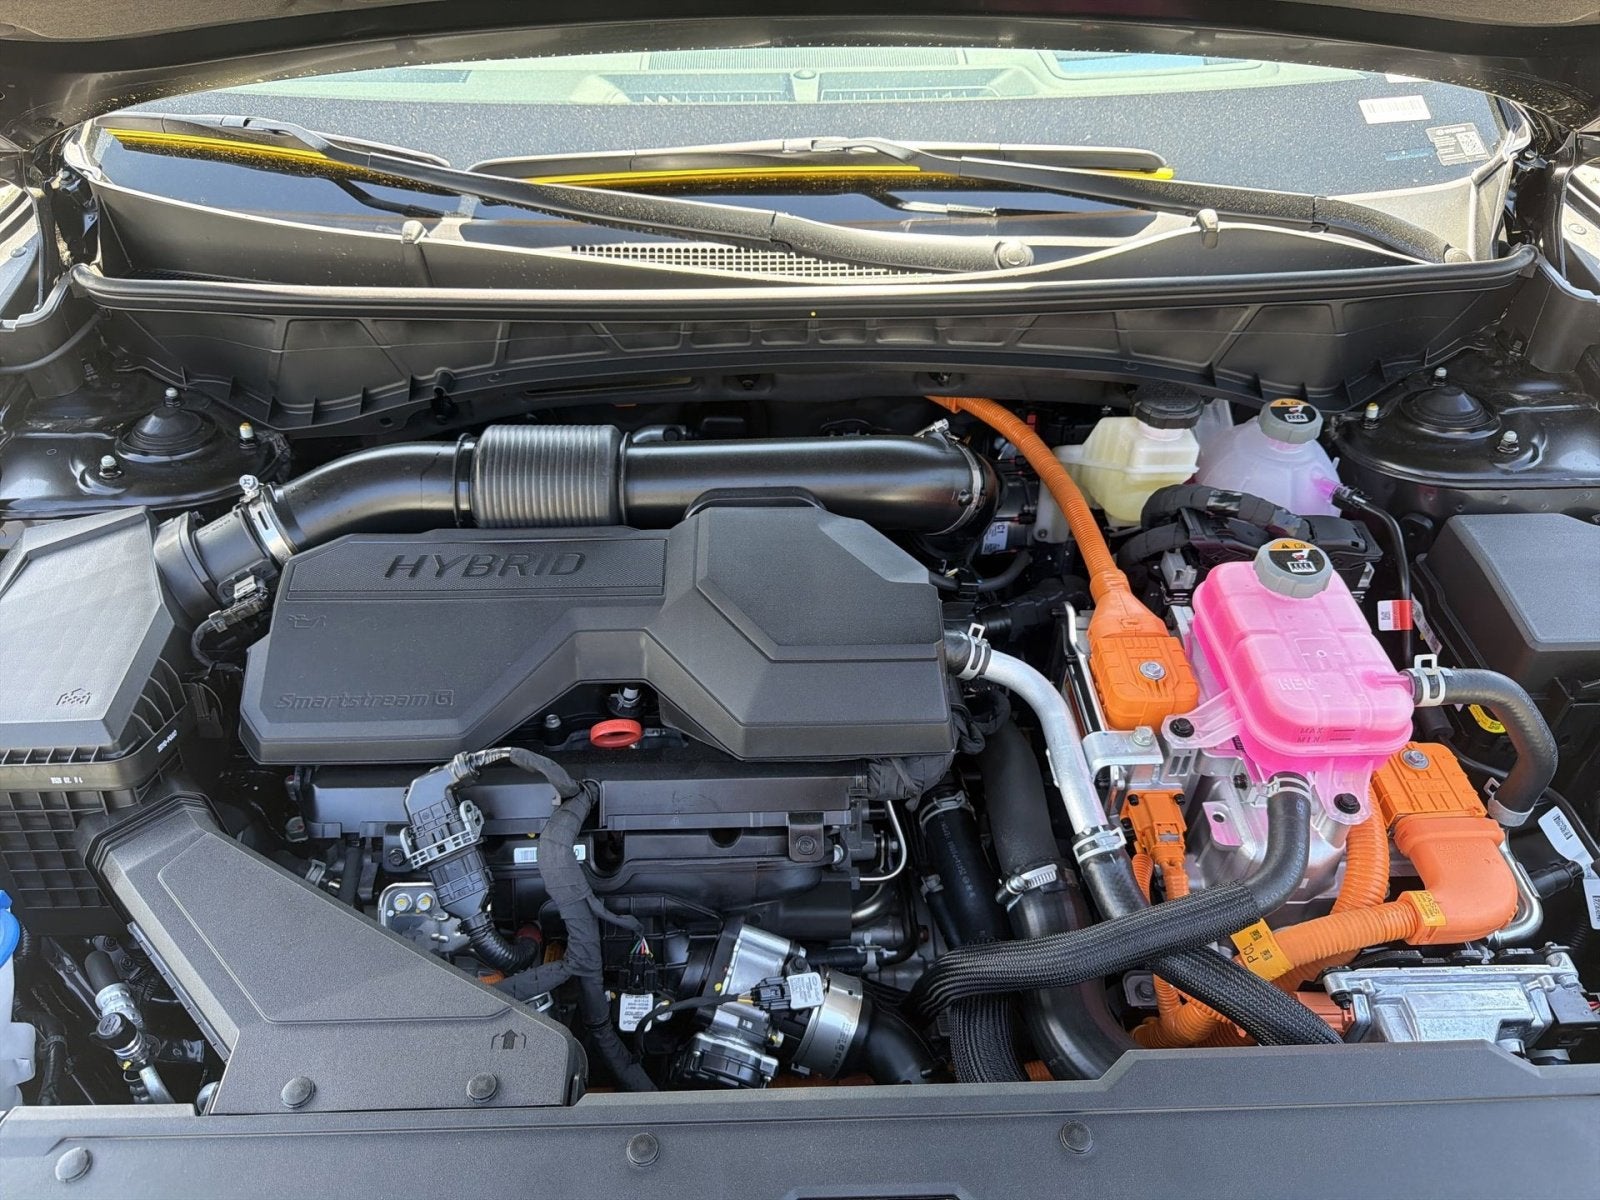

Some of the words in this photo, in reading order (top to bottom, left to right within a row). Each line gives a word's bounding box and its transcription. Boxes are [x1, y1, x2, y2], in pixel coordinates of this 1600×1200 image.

[384, 551, 587, 578] HYBRID
[276, 691, 430, 709] Smartstream
[1298, 727, 1323, 735] MAX
[1295, 736, 1321, 744] MIN
